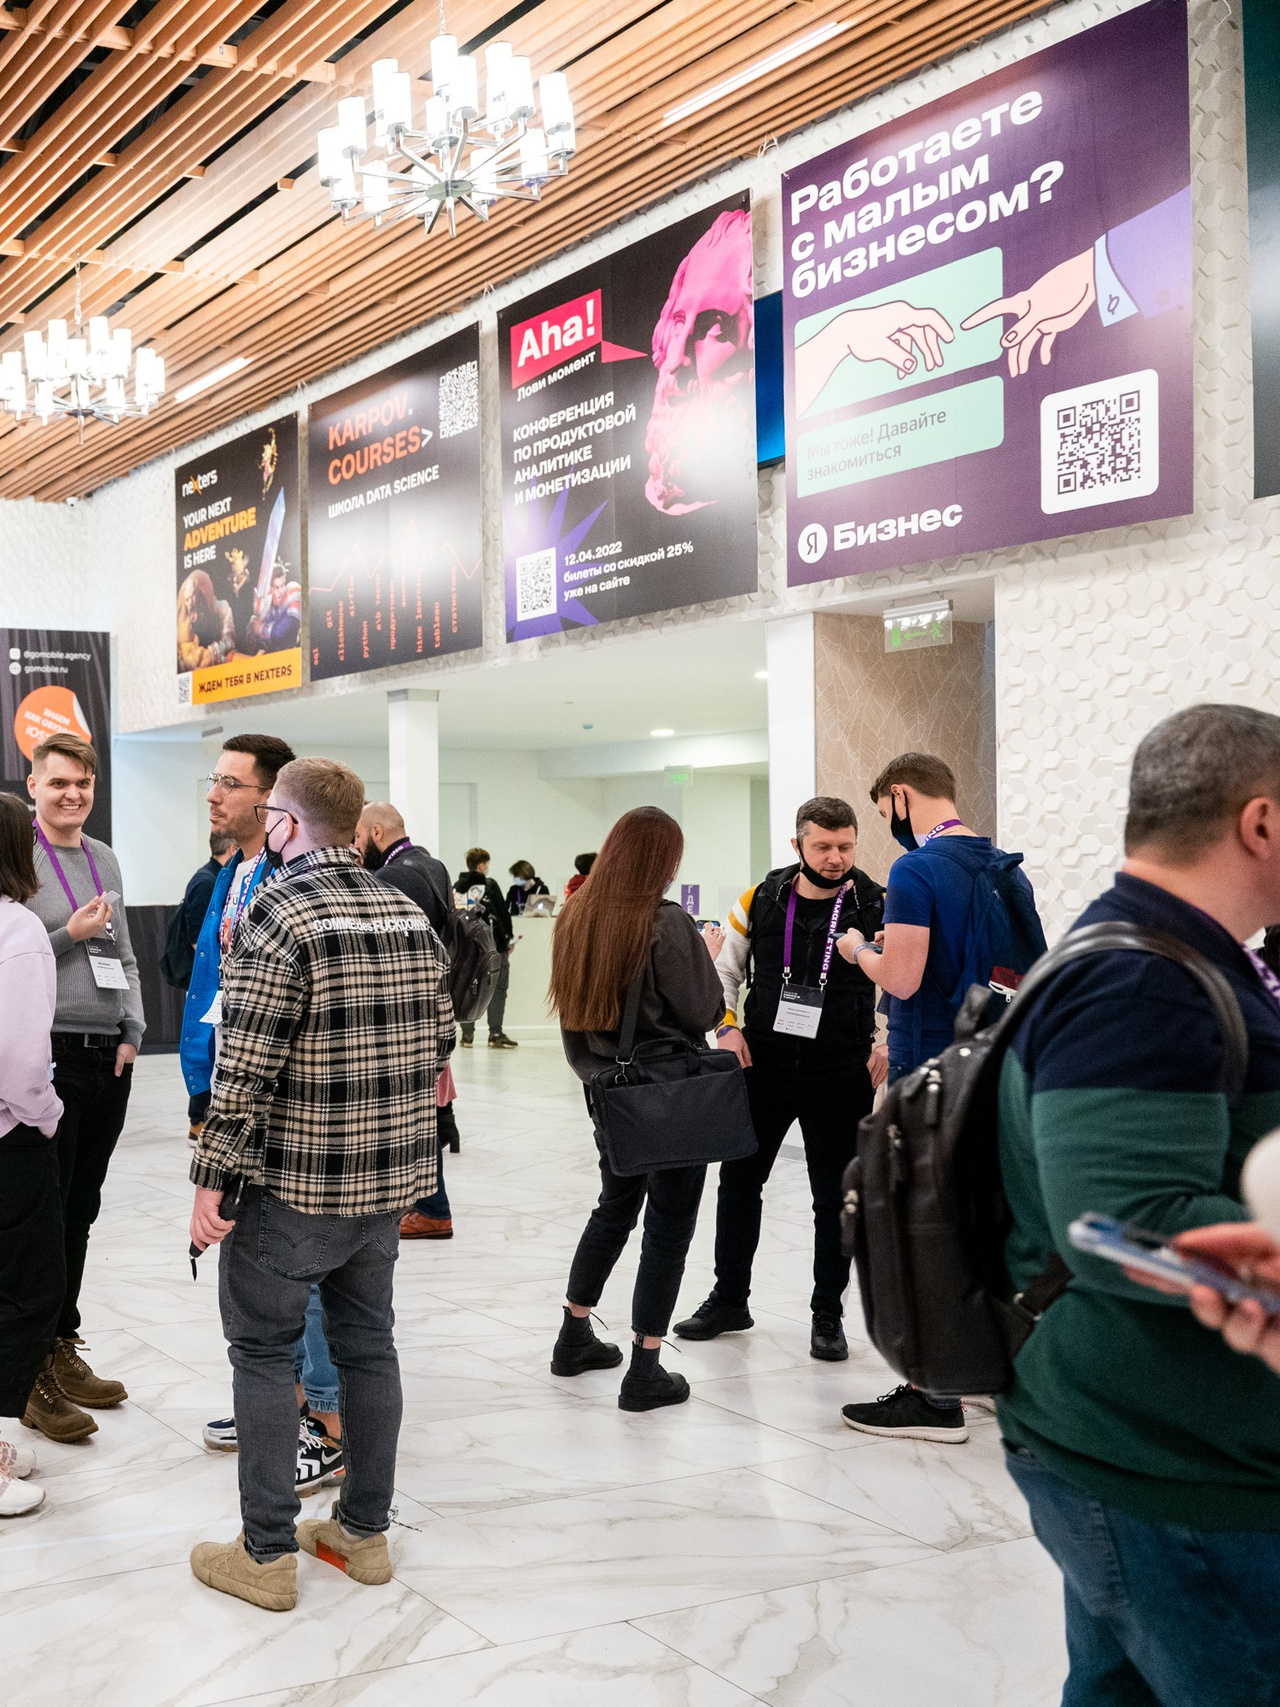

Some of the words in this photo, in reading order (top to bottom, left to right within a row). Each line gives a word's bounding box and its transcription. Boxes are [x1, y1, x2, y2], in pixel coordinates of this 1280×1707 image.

[790, 90, 1043, 226] Работаете
[790, 231, 816, 261] с
[824, 154, 990, 251] малым
[790, 160, 1064, 299] бизнесом?
[517, 298, 596, 368] Aha!
[517, 378, 546, 402] Лови
[548, 351, 596, 385] момент
[513, 391, 614, 442] КОНФЕРЕНЦИЯ
[514, 445, 531, 463] ПО
[533, 403, 636, 456] ПРОДУКТОВОЙ
[807, 445, 830, 461] Мы
[833, 427, 874, 452] тоже!
[877, 411, 947, 443] Давайте
[514, 445, 593, 484] АНАЛИТИКЕ
[515, 491, 524, 505] И
[526, 455, 631, 501] МОНЕТИЗАЦИИ
[807, 445, 902, 481] знакомиться
[183, 508, 207, 529] YOUR
[208, 496, 232, 519] NEXT
[328, 493, 365, 519] ШКОЛА
[367, 483, 392, 505] DATA
[394, 464, 440, 494] SCIENCE
[184, 506, 257, 551] ADVENTURE
[833, 503, 963, 552] Бизнес
[184, 554, 192, 569] IS
[193, 545, 217, 566] HERE
[563, 566, 602, 582] билеты
[603, 562, 617, 573] со
[618, 548, 665, 569] скидкой
[666, 541, 694, 558] 25%
[564, 541, 623, 566] 12.04.2022
[564, 587, 584, 601] уже
[585, 584, 598, 594] на
[599, 576, 630, 591] сайте
[199, 678, 222, 693] ЖДЕМ
[225, 674, 244, 688] ТЕБЯ
[246, 673, 252, 684] В
[254, 665, 292, 682] NEXTERS
